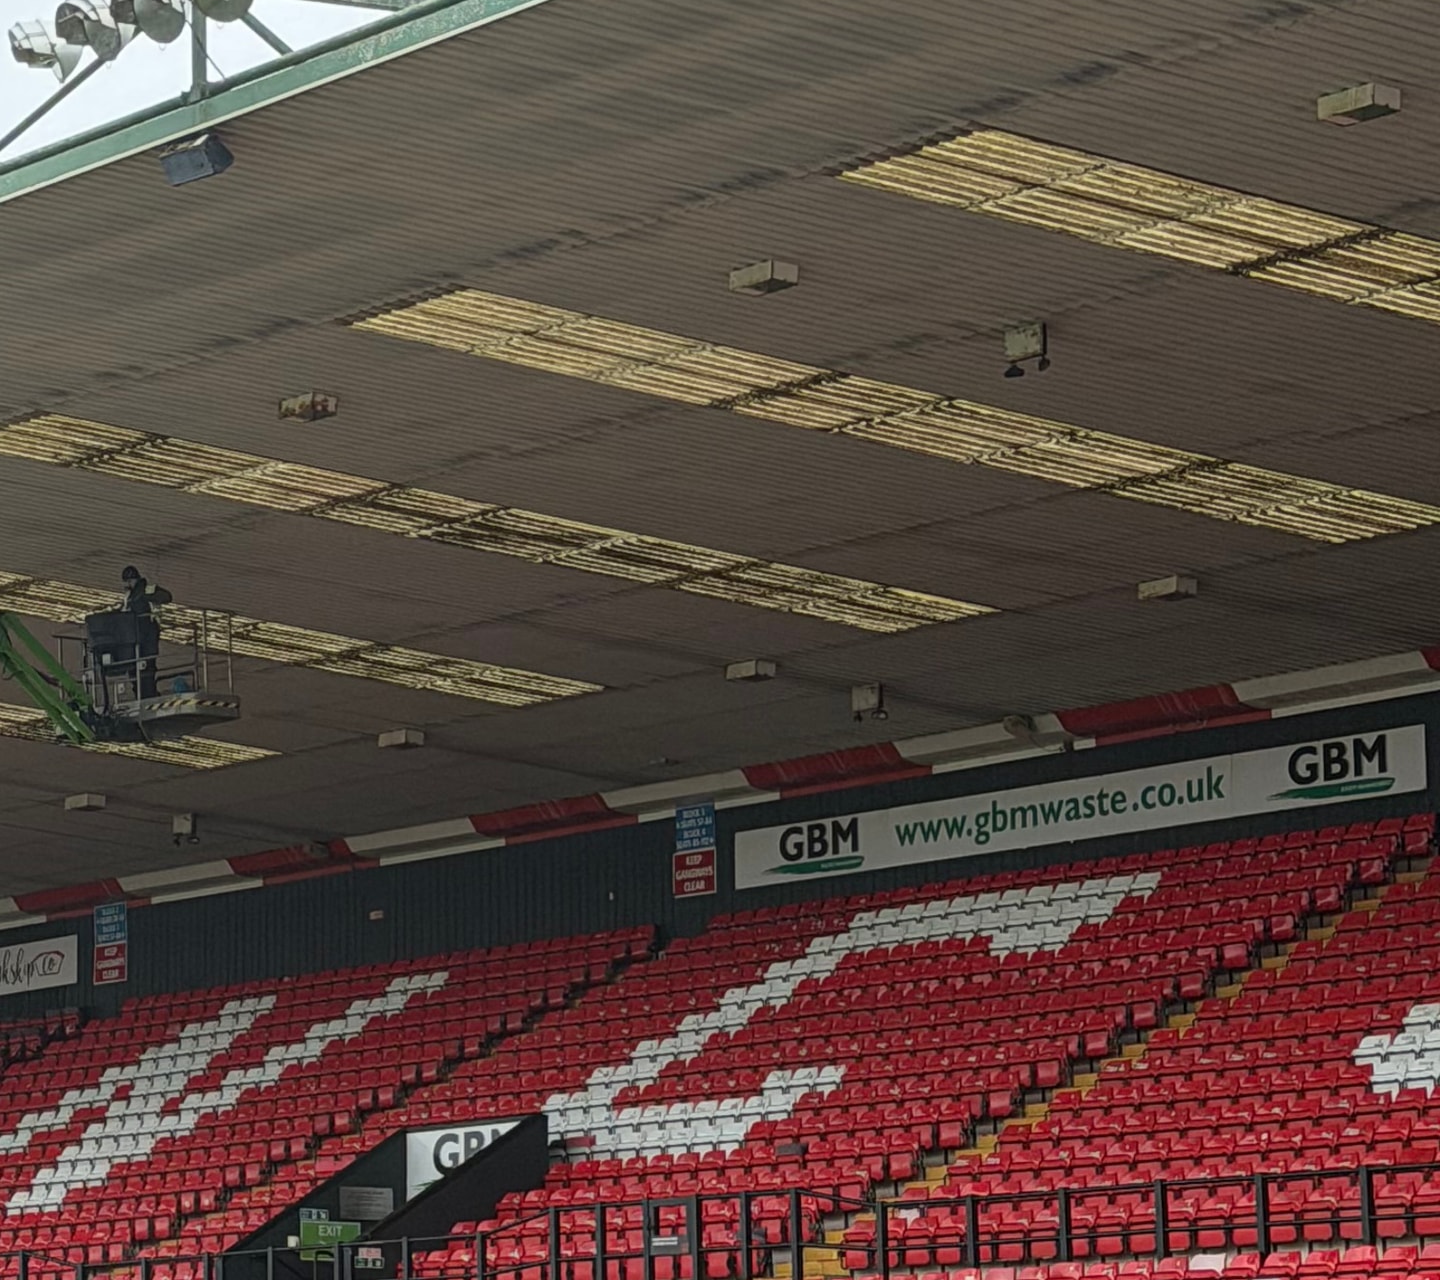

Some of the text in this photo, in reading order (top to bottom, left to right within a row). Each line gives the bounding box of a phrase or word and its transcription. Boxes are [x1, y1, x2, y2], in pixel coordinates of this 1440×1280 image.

[1288, 733, 1388, 785] GBM
[895, 765, 1225, 849] www.gbmwaste.co.uk
[779, 817, 859, 862] GBM
[685, 854, 703, 866] KEEP
[683, 879, 706, 893] CLEAR
[318, 1225, 343, 1237] EXIT
